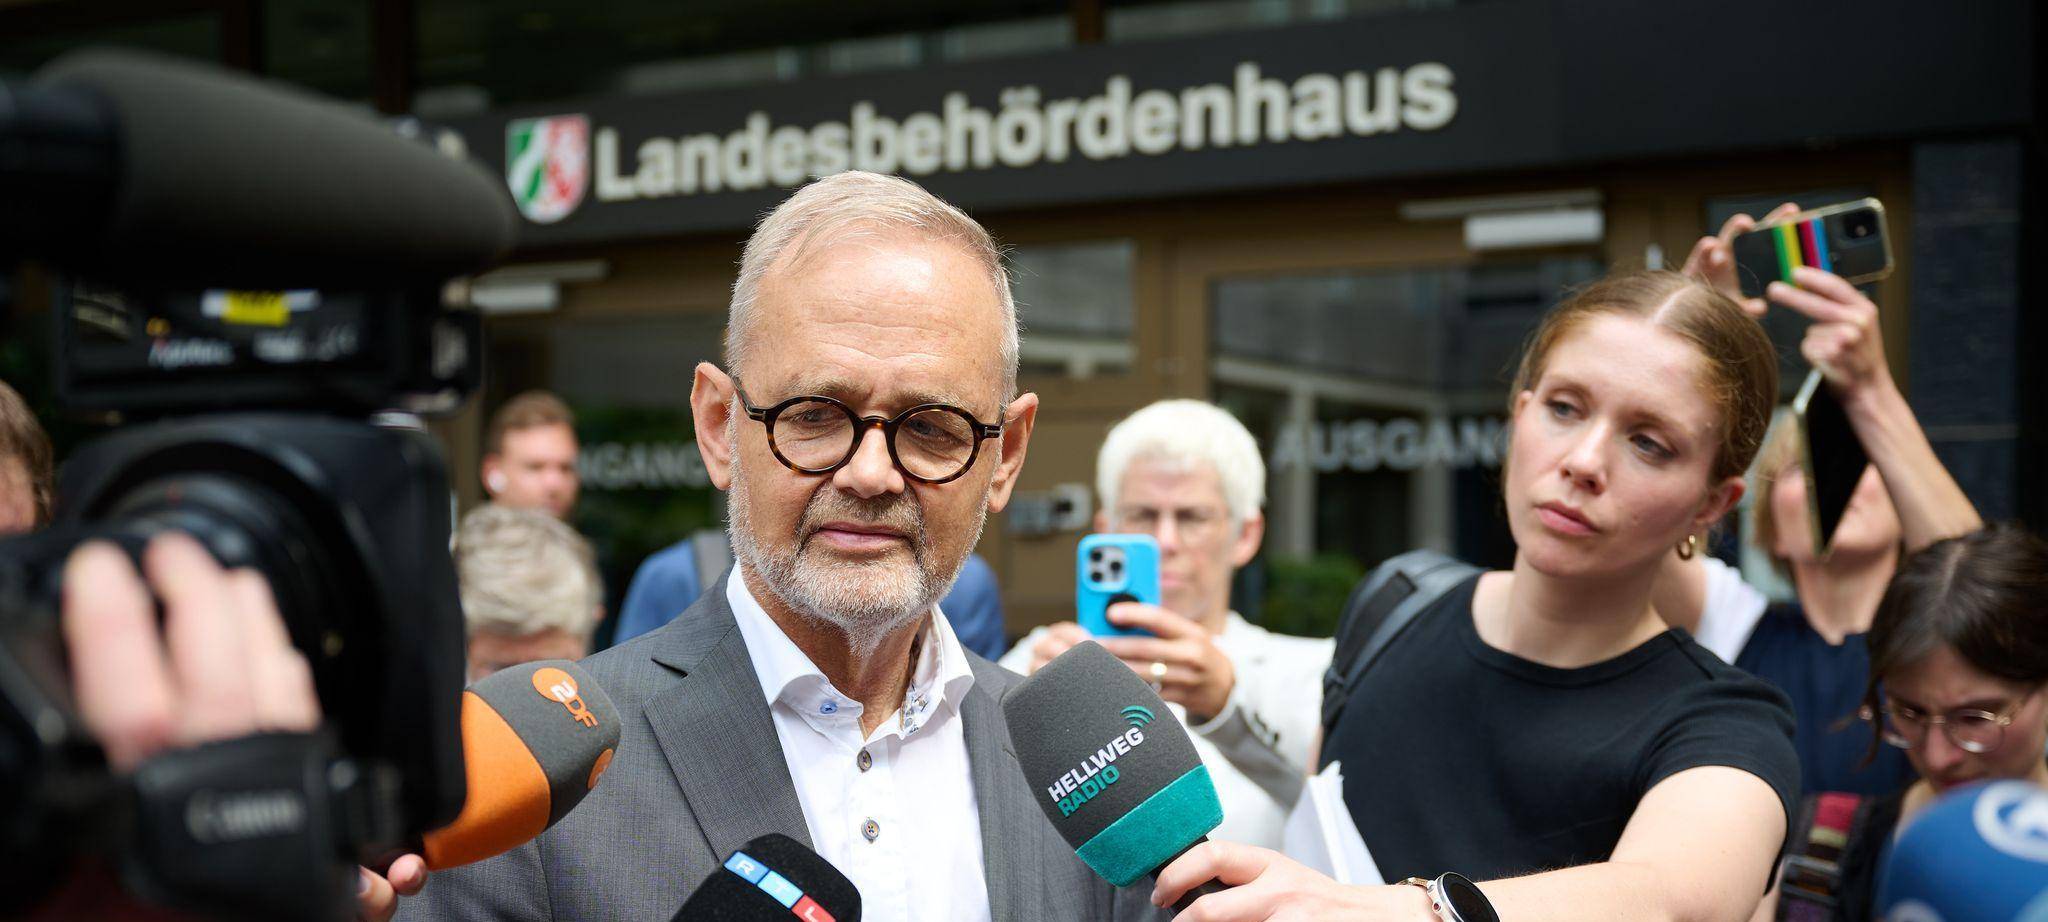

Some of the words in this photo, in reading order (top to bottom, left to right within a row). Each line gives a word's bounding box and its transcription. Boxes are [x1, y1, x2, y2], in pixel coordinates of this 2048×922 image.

[595, 61, 1458, 201] Landesbehördenhaus
[1270, 417, 1512, 474] AUSGAN
[1047, 726, 1144, 803] HELLWEG
[1057, 764, 1120, 817] RADIO
